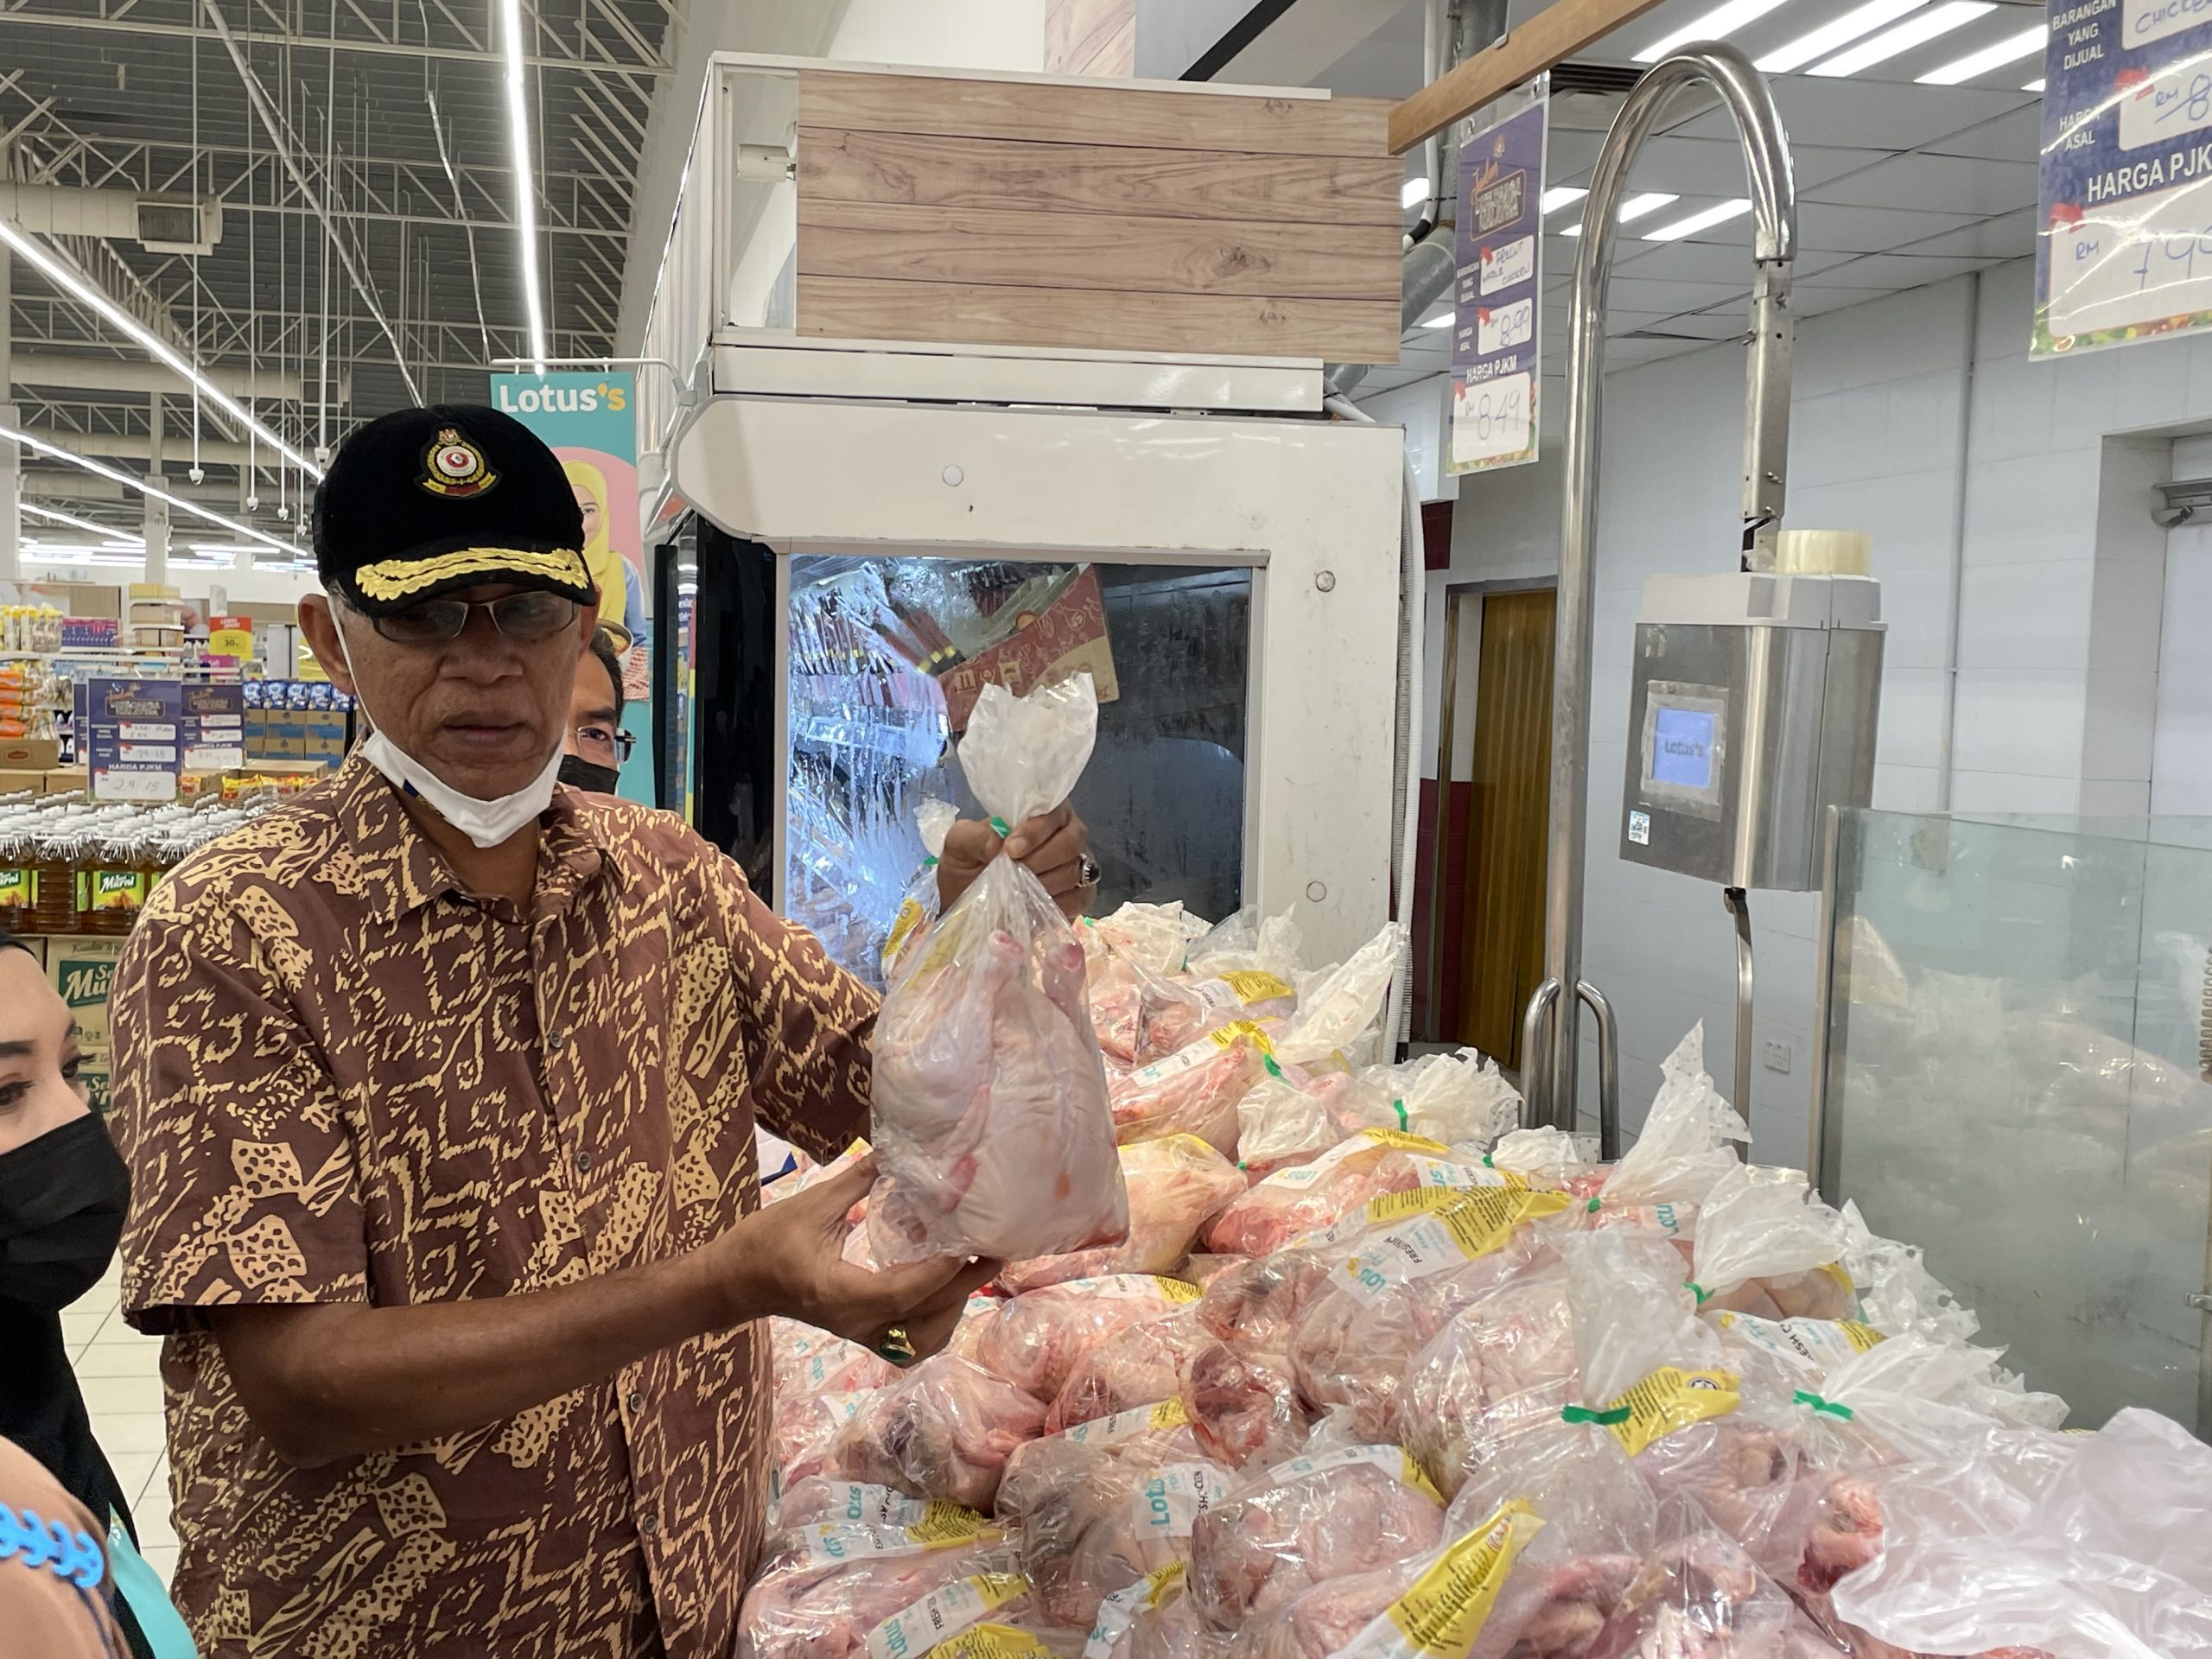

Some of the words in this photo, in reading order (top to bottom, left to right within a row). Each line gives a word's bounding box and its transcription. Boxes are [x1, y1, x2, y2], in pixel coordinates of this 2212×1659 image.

[2052, 0, 2117, 30] BARANGAN
[2068, 22, 2100, 47] YANG
[2063, 44, 2104, 70] DIJUAL
[2064, 130, 2096, 152] ASAL
[2088, 158, 2164, 203] HARGA
[2075, 239, 2100, 261] RM
[1466, 361, 1493, 385] HARGA
[1495, 354, 1517, 376] PJKM
[499, 383, 626, 413] Lotus's
[99, 876, 135, 894] Murni
